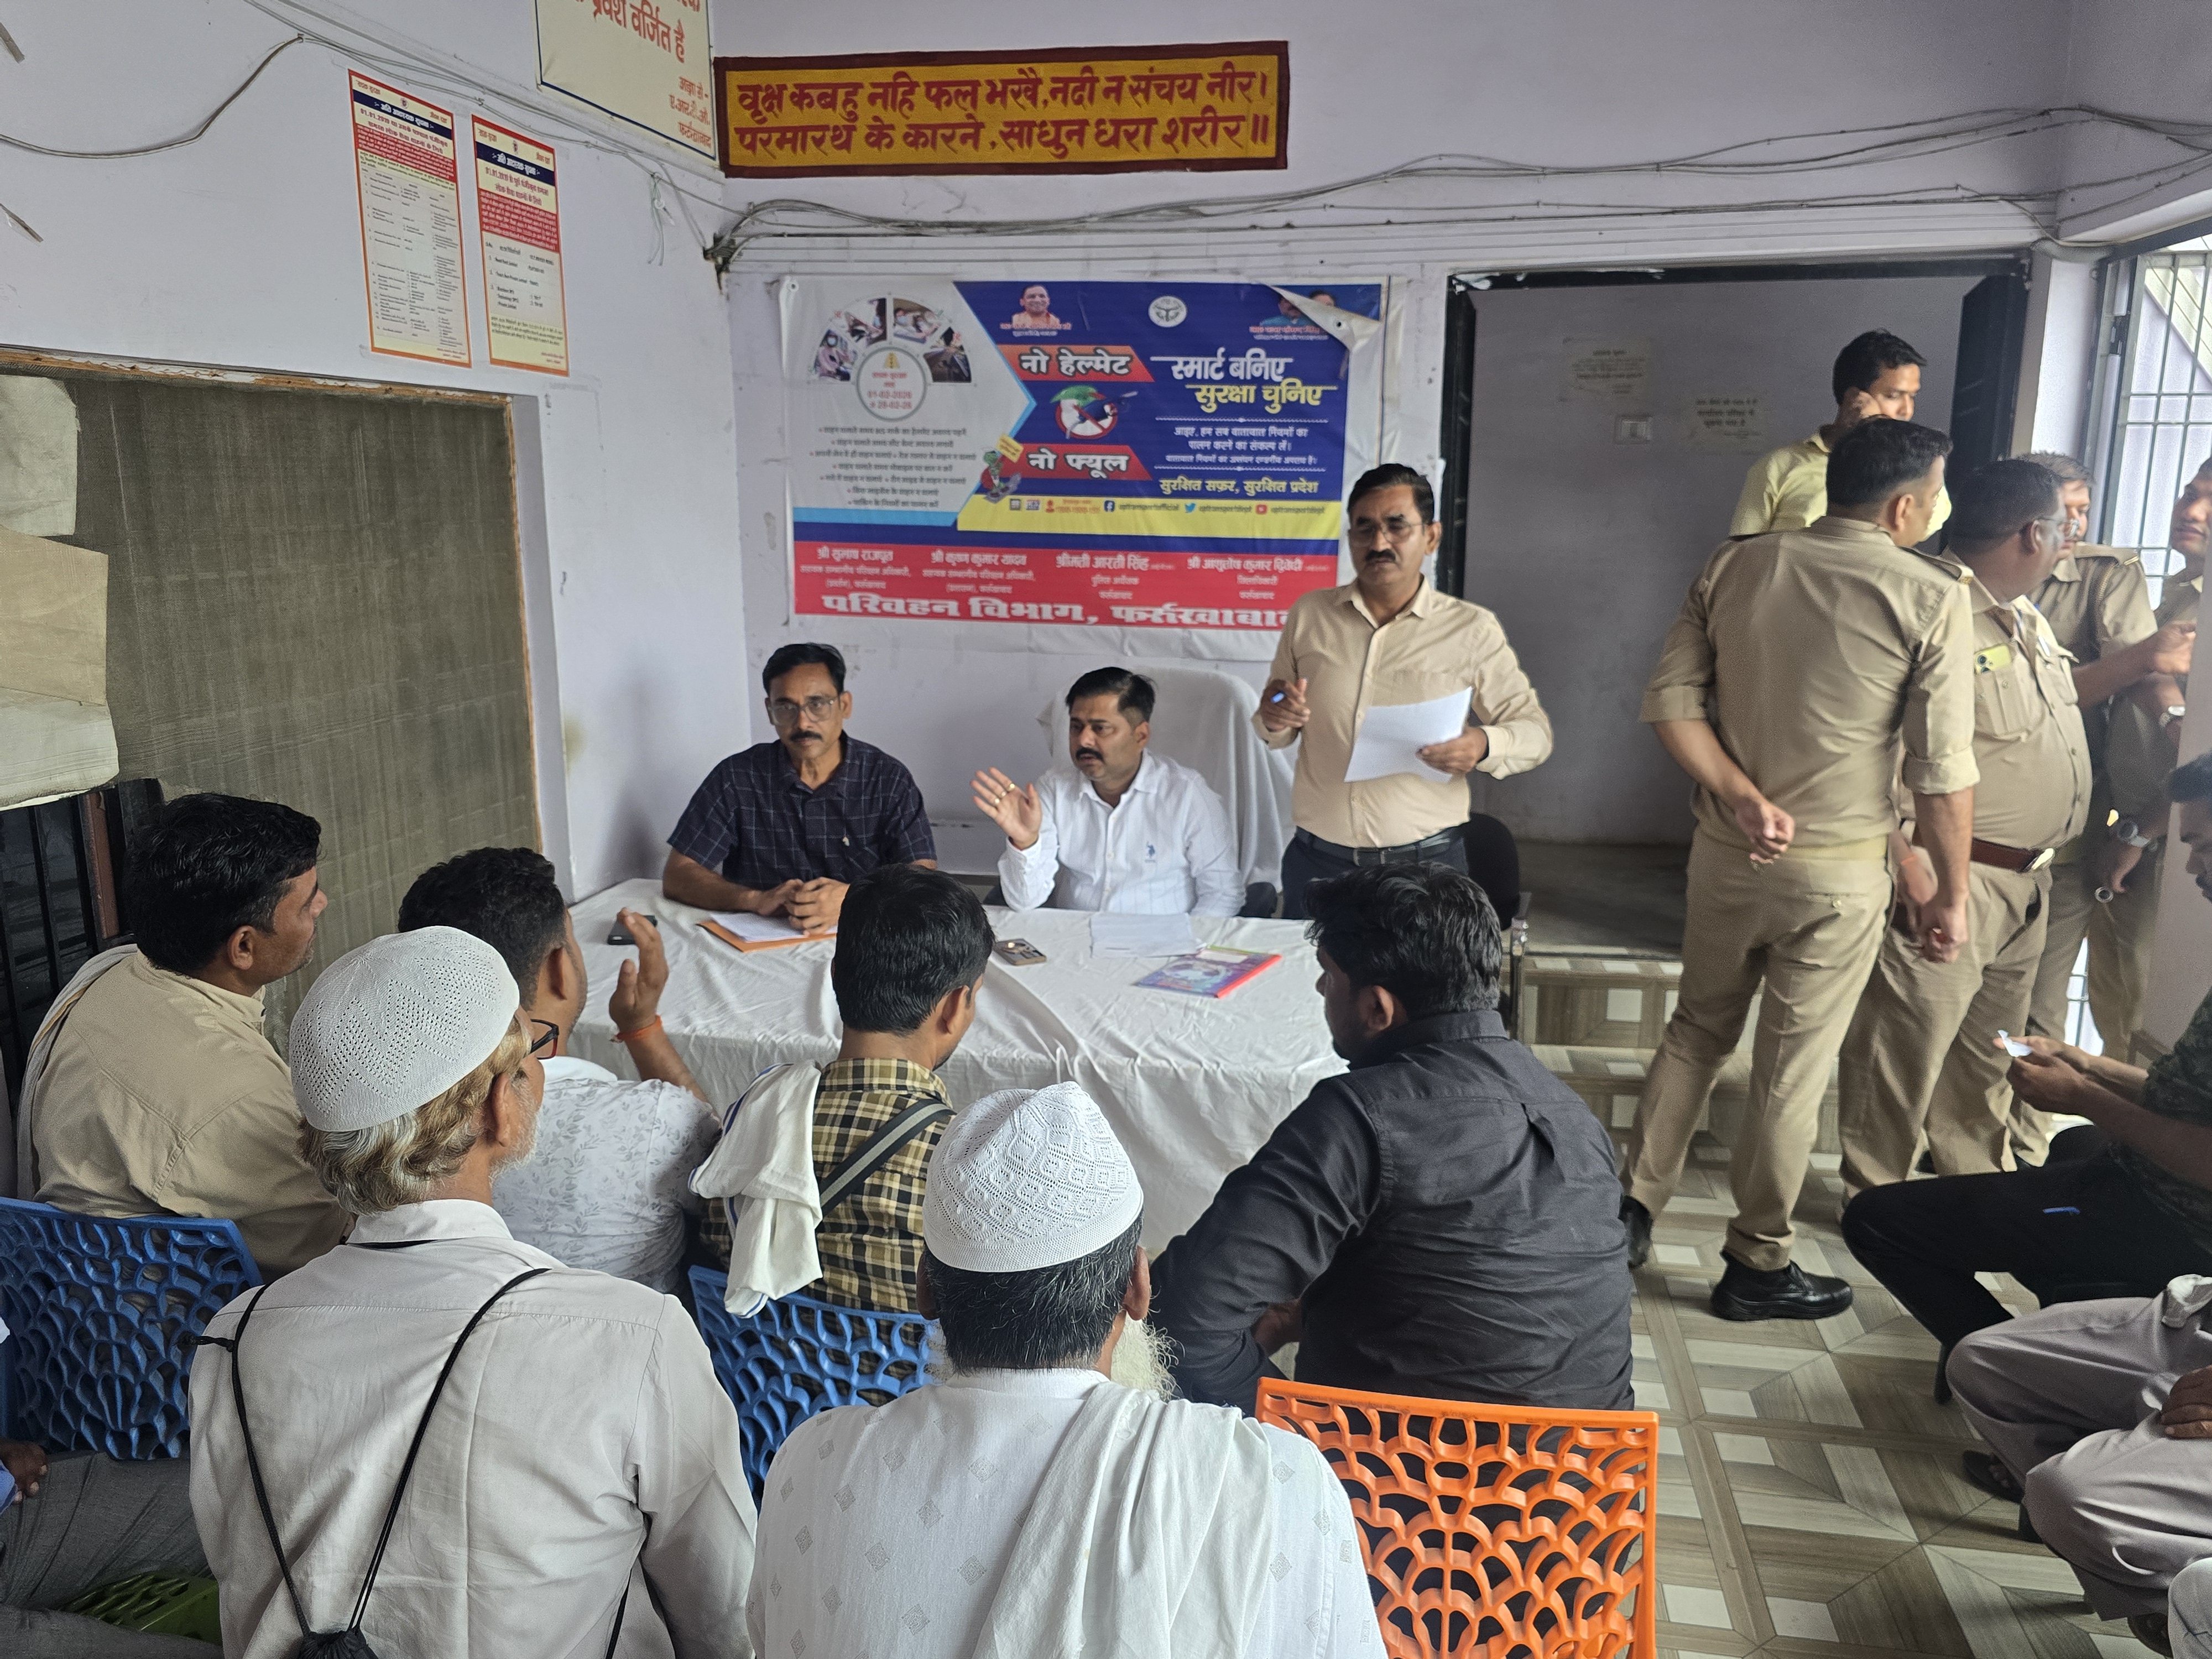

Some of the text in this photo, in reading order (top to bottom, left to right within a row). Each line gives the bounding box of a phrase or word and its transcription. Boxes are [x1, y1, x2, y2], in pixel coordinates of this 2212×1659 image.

[630, 1, 671, 53] वर्जित
[674, 18, 685, 64] है
[737, 84, 788, 124] वृक्ष
[790, 82, 864, 122] कबहु
[867, 71, 920, 118] नहि
[924, 80, 981, 111] फल
[1051, 65, 1098, 109] नदी
[1104, 76, 1125, 103] न
[1128, 66, 1202, 107] संचय
[734, 123, 857, 159] परमारथ
[864, 116, 894, 151] के
[1094, 117, 1157, 153] धरा
[1020, 348, 1132, 376] नो हेल्मेट
[1150, 347, 1293, 382] स्मार्ट बनिए
[1186, 378, 1337, 413] सुरक्षा चुनिए
[1027, 447, 1130, 479] नो फ्यूल
[1159, 474, 1202, 494] सुरक्षित
[1243, 476, 1287, 495] सुरक्षित
[1290, 477, 1318, 493] प्रदेश
[822, 592, 960, 617] परिवहन
